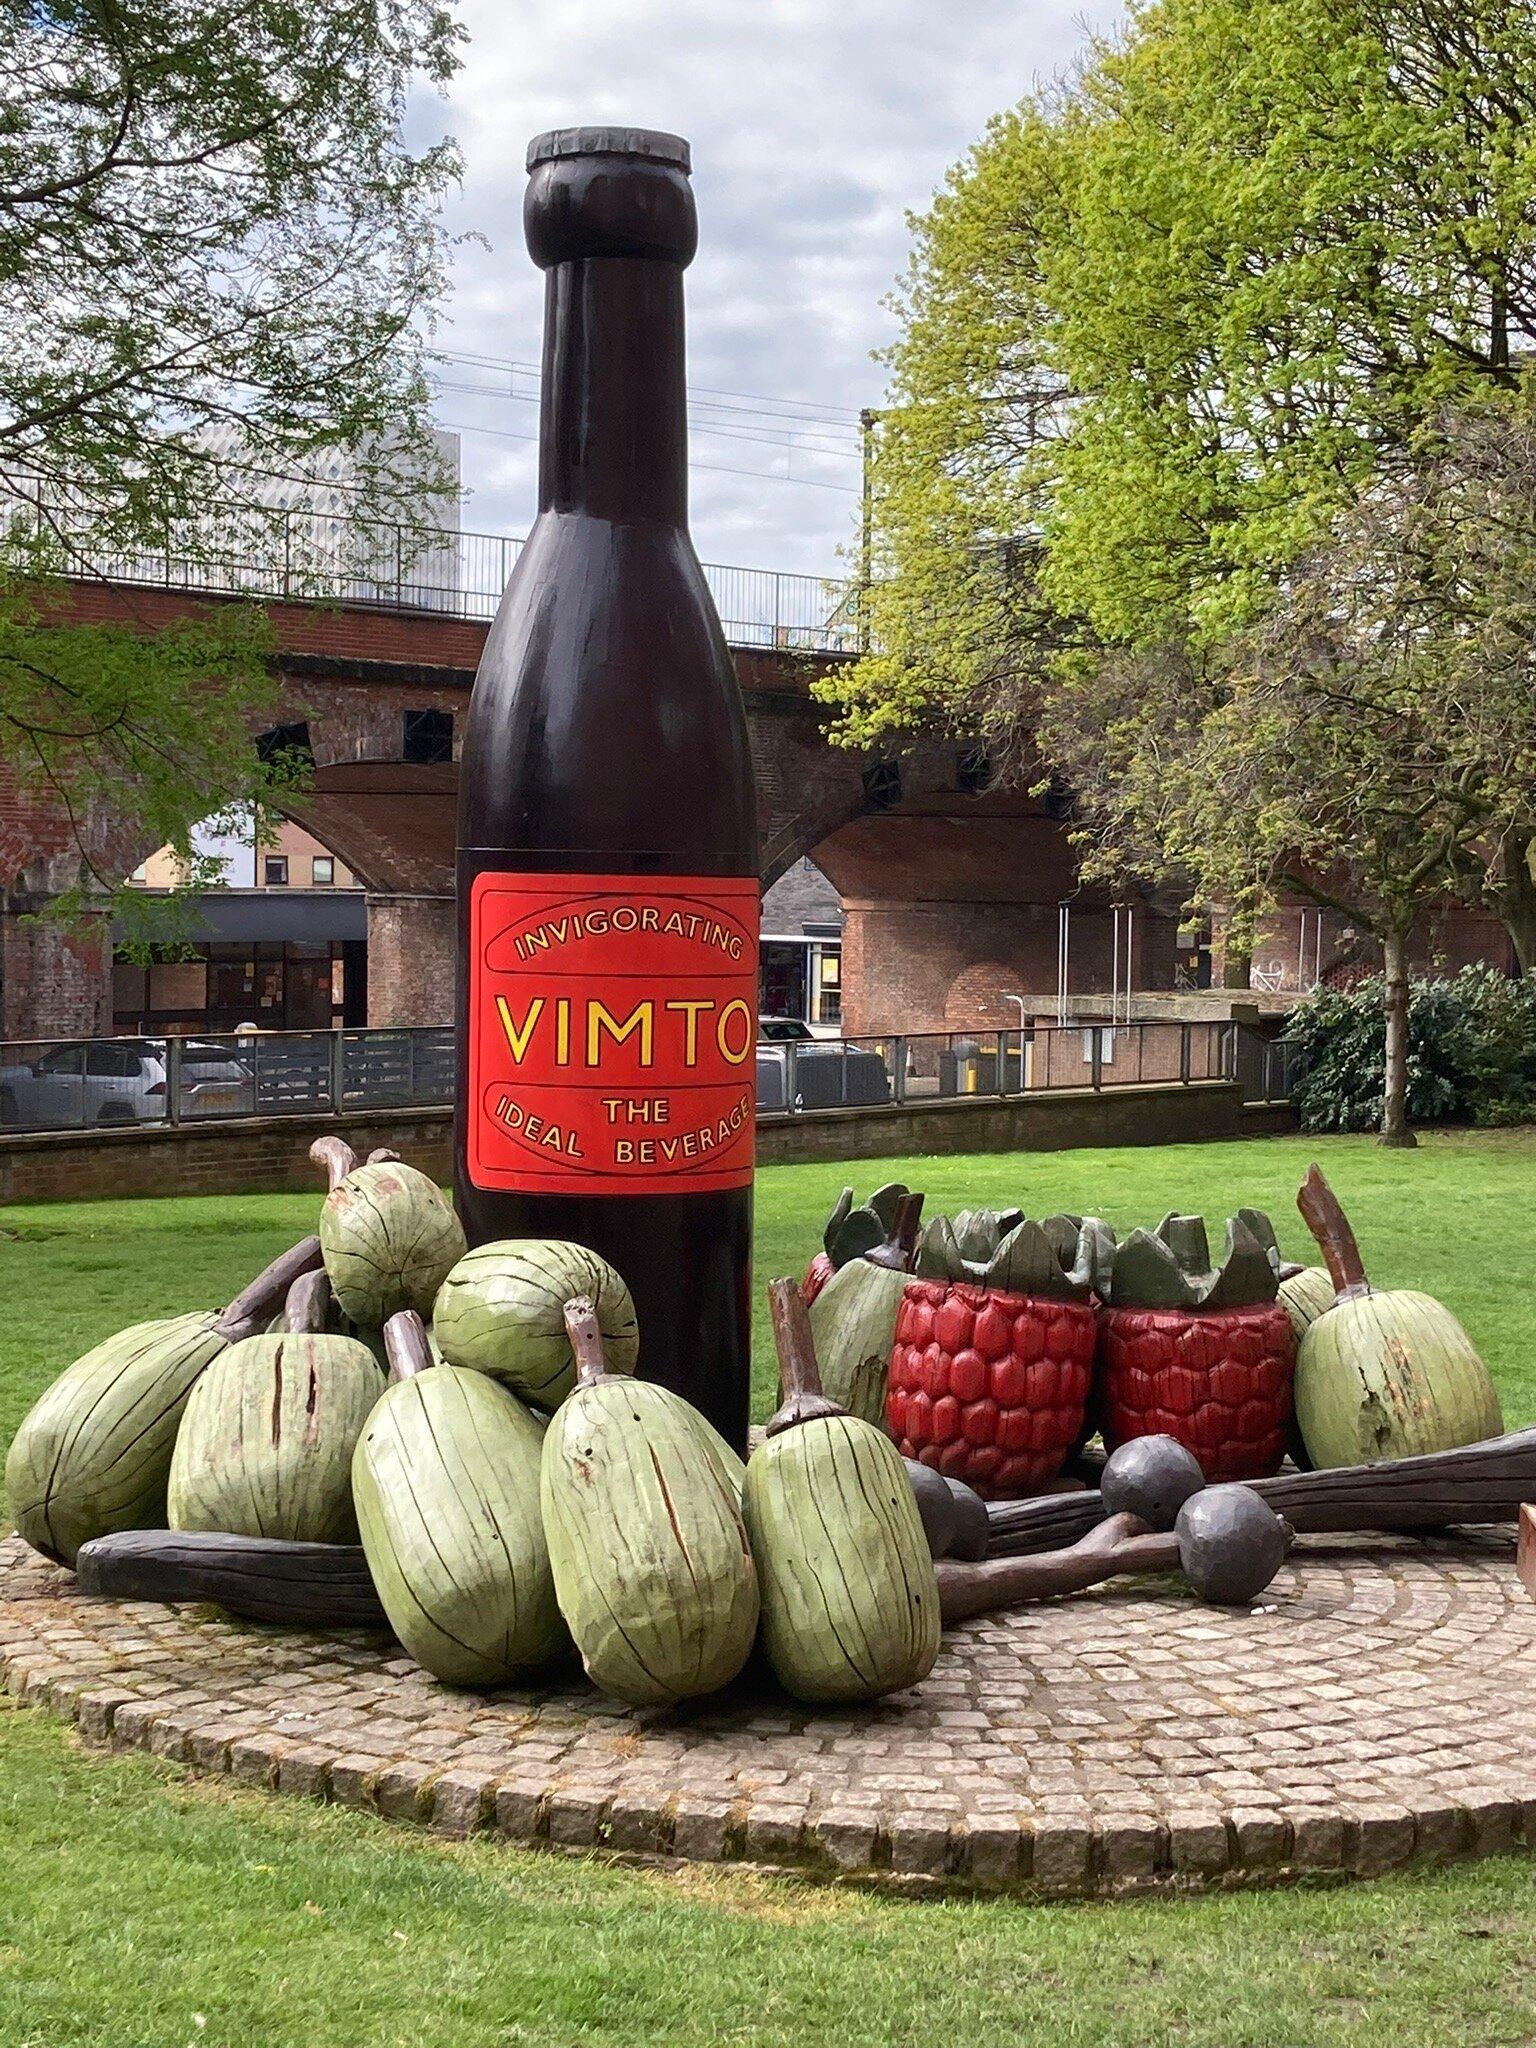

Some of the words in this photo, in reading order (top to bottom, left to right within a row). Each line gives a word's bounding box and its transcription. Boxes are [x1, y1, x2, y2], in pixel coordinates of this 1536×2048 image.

[514, 906, 744, 961] INVIGORATING
[495, 995, 752, 1067] VIMTO
[495, 1094, 585, 1158] IDEAL
[615, 1094, 750, 1164] BEVERAGE
[602, 1098, 670, 1123] THE
